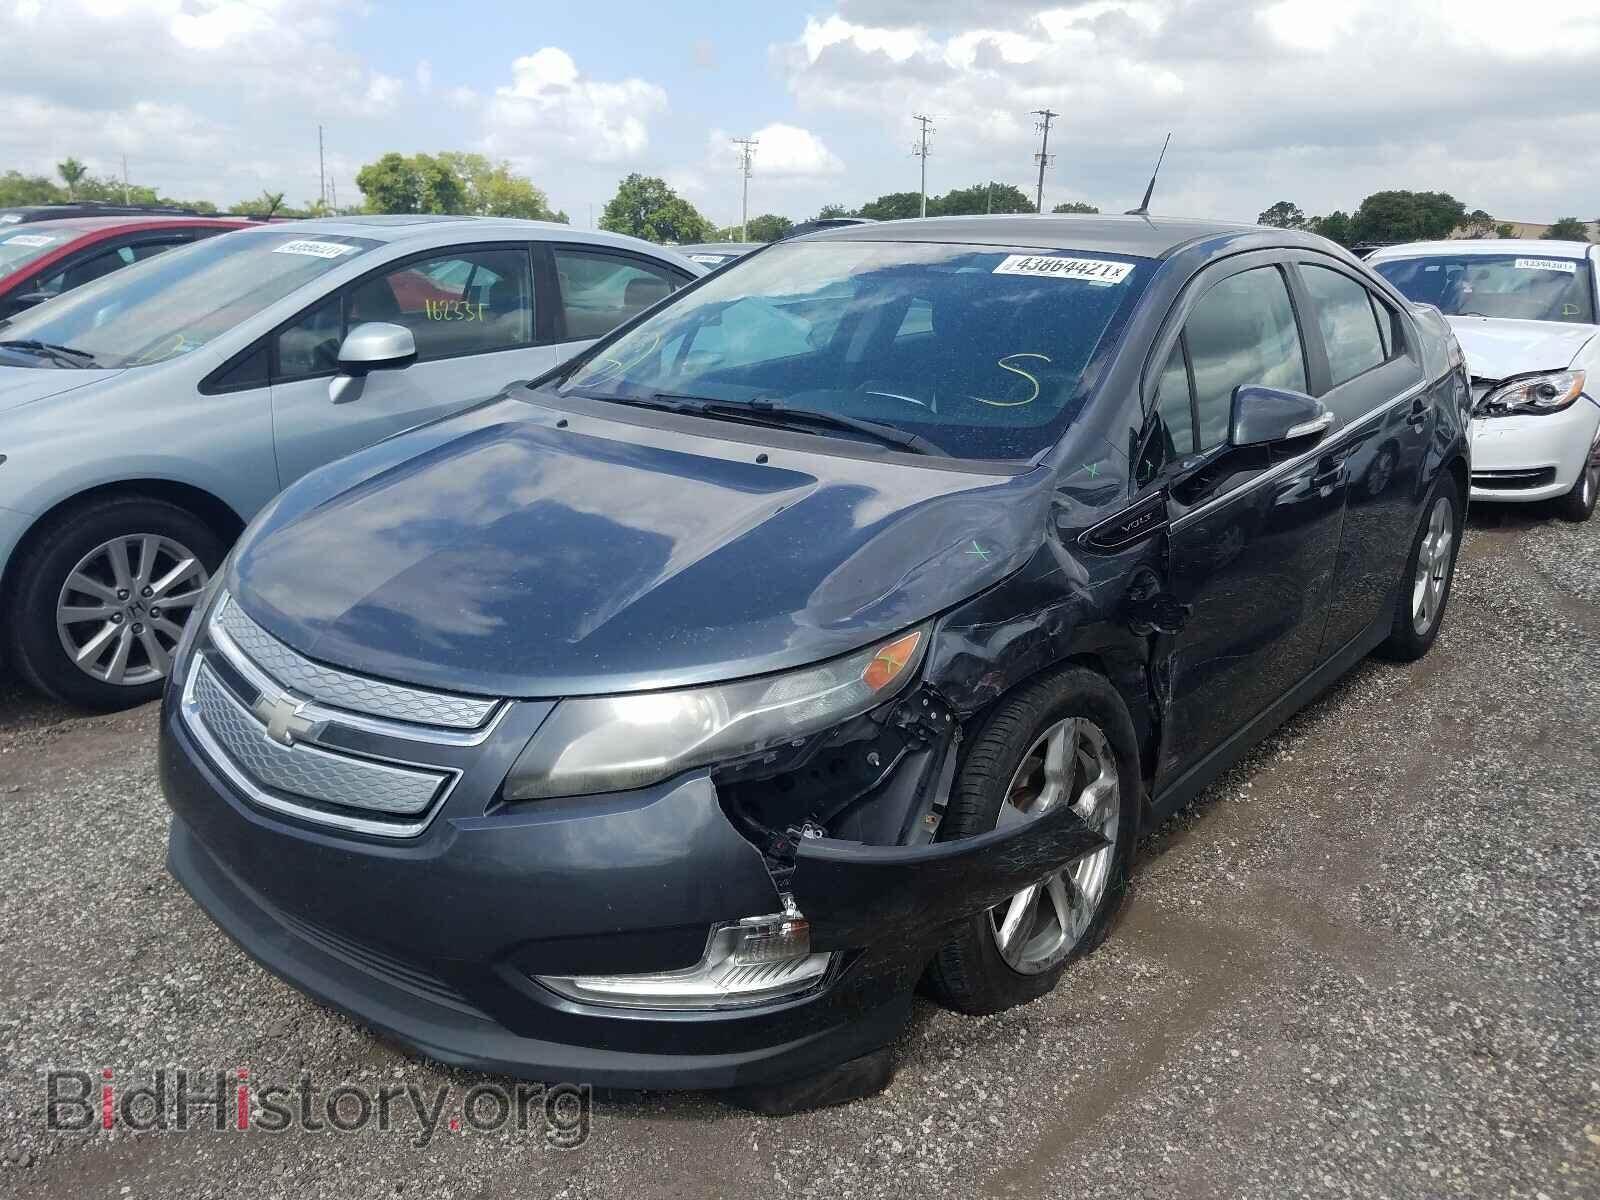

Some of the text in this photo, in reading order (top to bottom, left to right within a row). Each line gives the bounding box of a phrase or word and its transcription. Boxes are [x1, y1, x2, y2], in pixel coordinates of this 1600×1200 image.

[1016, 257, 1111, 277] 43864421
[968, 353, 1052, 407] S
[1120, 512, 1154, 532] VOLT
